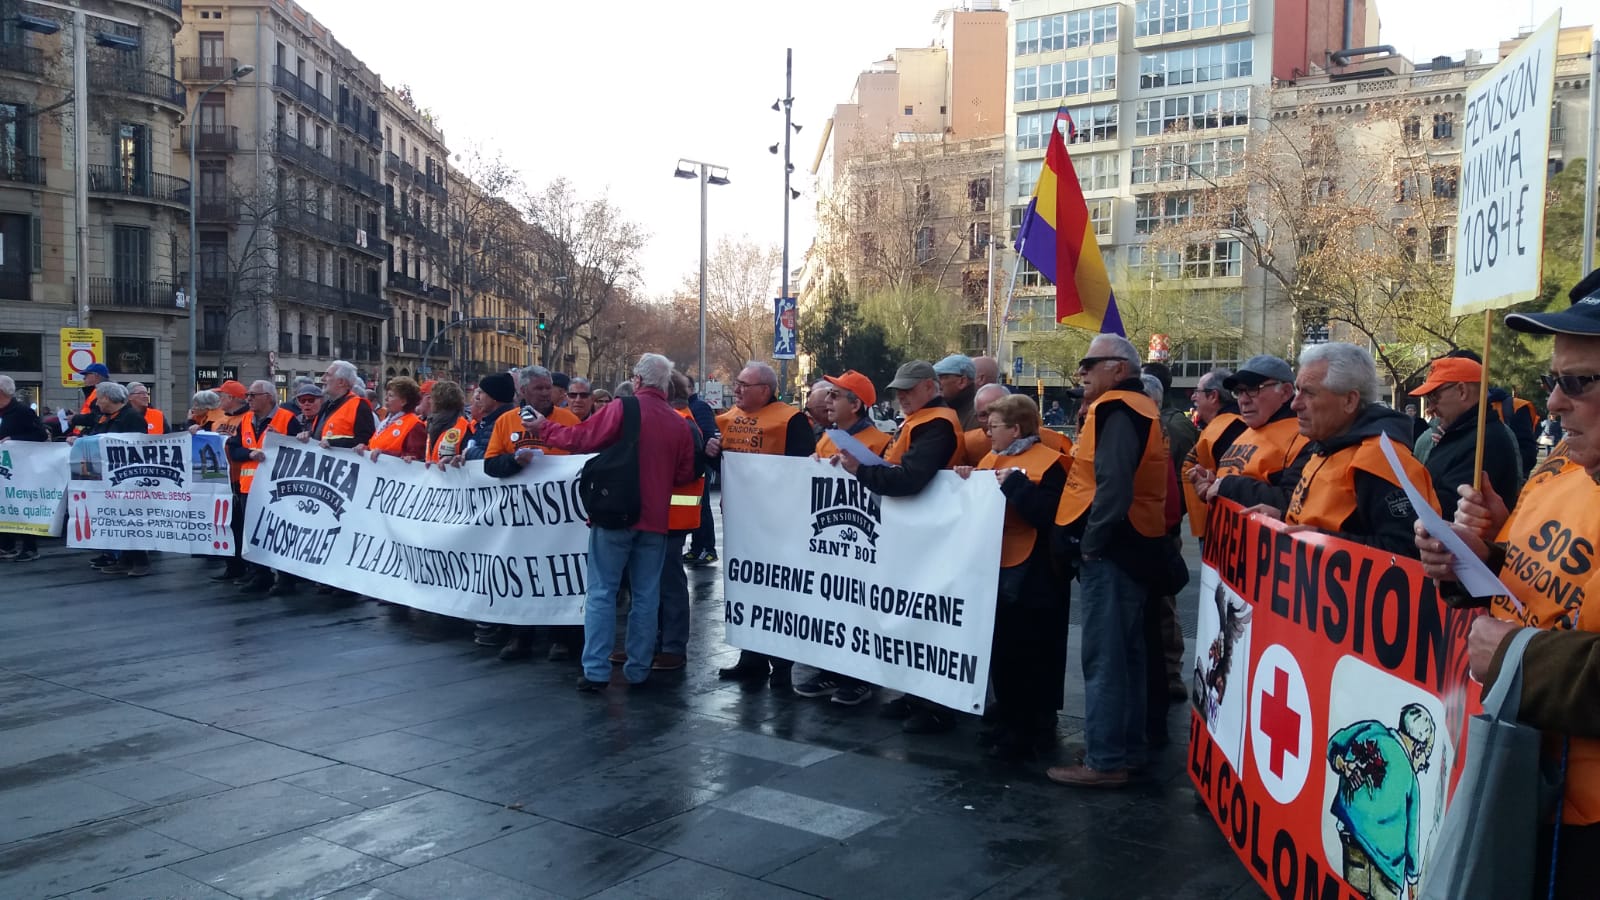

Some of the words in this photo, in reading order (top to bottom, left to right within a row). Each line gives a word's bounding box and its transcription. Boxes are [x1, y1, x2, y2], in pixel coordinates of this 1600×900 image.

[1464, 49, 1541, 152] PENSION
[1461, 128, 1523, 214] MINIMA
[198, 370, 234, 379] FARMCIA
[734, 416, 759, 426] SOS
[106, 445, 185, 473] MAREA
[118, 467, 179, 479] PENSIONISTA
[270, 446, 361, 502] MAREA
[5, 487, 38, 502] Menys
[97, 507, 117, 516] POR
[119, 508, 144, 517] LAS
[146, 508, 206, 520] PENSIONES
[104, 490, 122, 500] SANT
[152, 491, 168, 500] DEL
[280, 483, 341, 508] PENSIONISTA
[365, 477, 406, 517] POR
[500, 467, 587, 527] PENSIÓ
[810, 476, 882, 524] MAREA
[91, 529, 97, 537] Y
[100, 529, 153, 539] FUTUROS
[155, 532, 212, 543] JUBILADOS
[147, 519, 174, 529] PARA
[175, 521, 213, 531] TODOS
[250, 506, 341, 565] L'HOSPITALET
[819, 511, 874, 531] PENSIONISTA
[346, 532, 367, 566] Y
[357, 535, 387, 573] LA
[400, 543, 470, 592] NUESTROS
[470, 551, 524, 608] HIJOS
[524, 556, 545, 597] E
[546, 552, 589, 597] HI
[809, 538, 851, 557] SANT
[854, 545, 877, 565] BOI
[1202, 502, 1248, 595] MAREA
[1528, 519, 1594, 576] SOS
[728, 557, 815, 595] GOBIERNE
[819, 572, 866, 608] QUIEN
[869, 583, 965, 627] GOBIERNE
[1502, 539, 1585, 610] PENSIONE
[725, 600, 744, 626] AS
[750, 604, 846, 649] PENSIONES
[851, 626, 870, 656] SE
[874, 633, 978, 685] DEFIENDEN
[1217, 761, 1364, 900] COLOM
